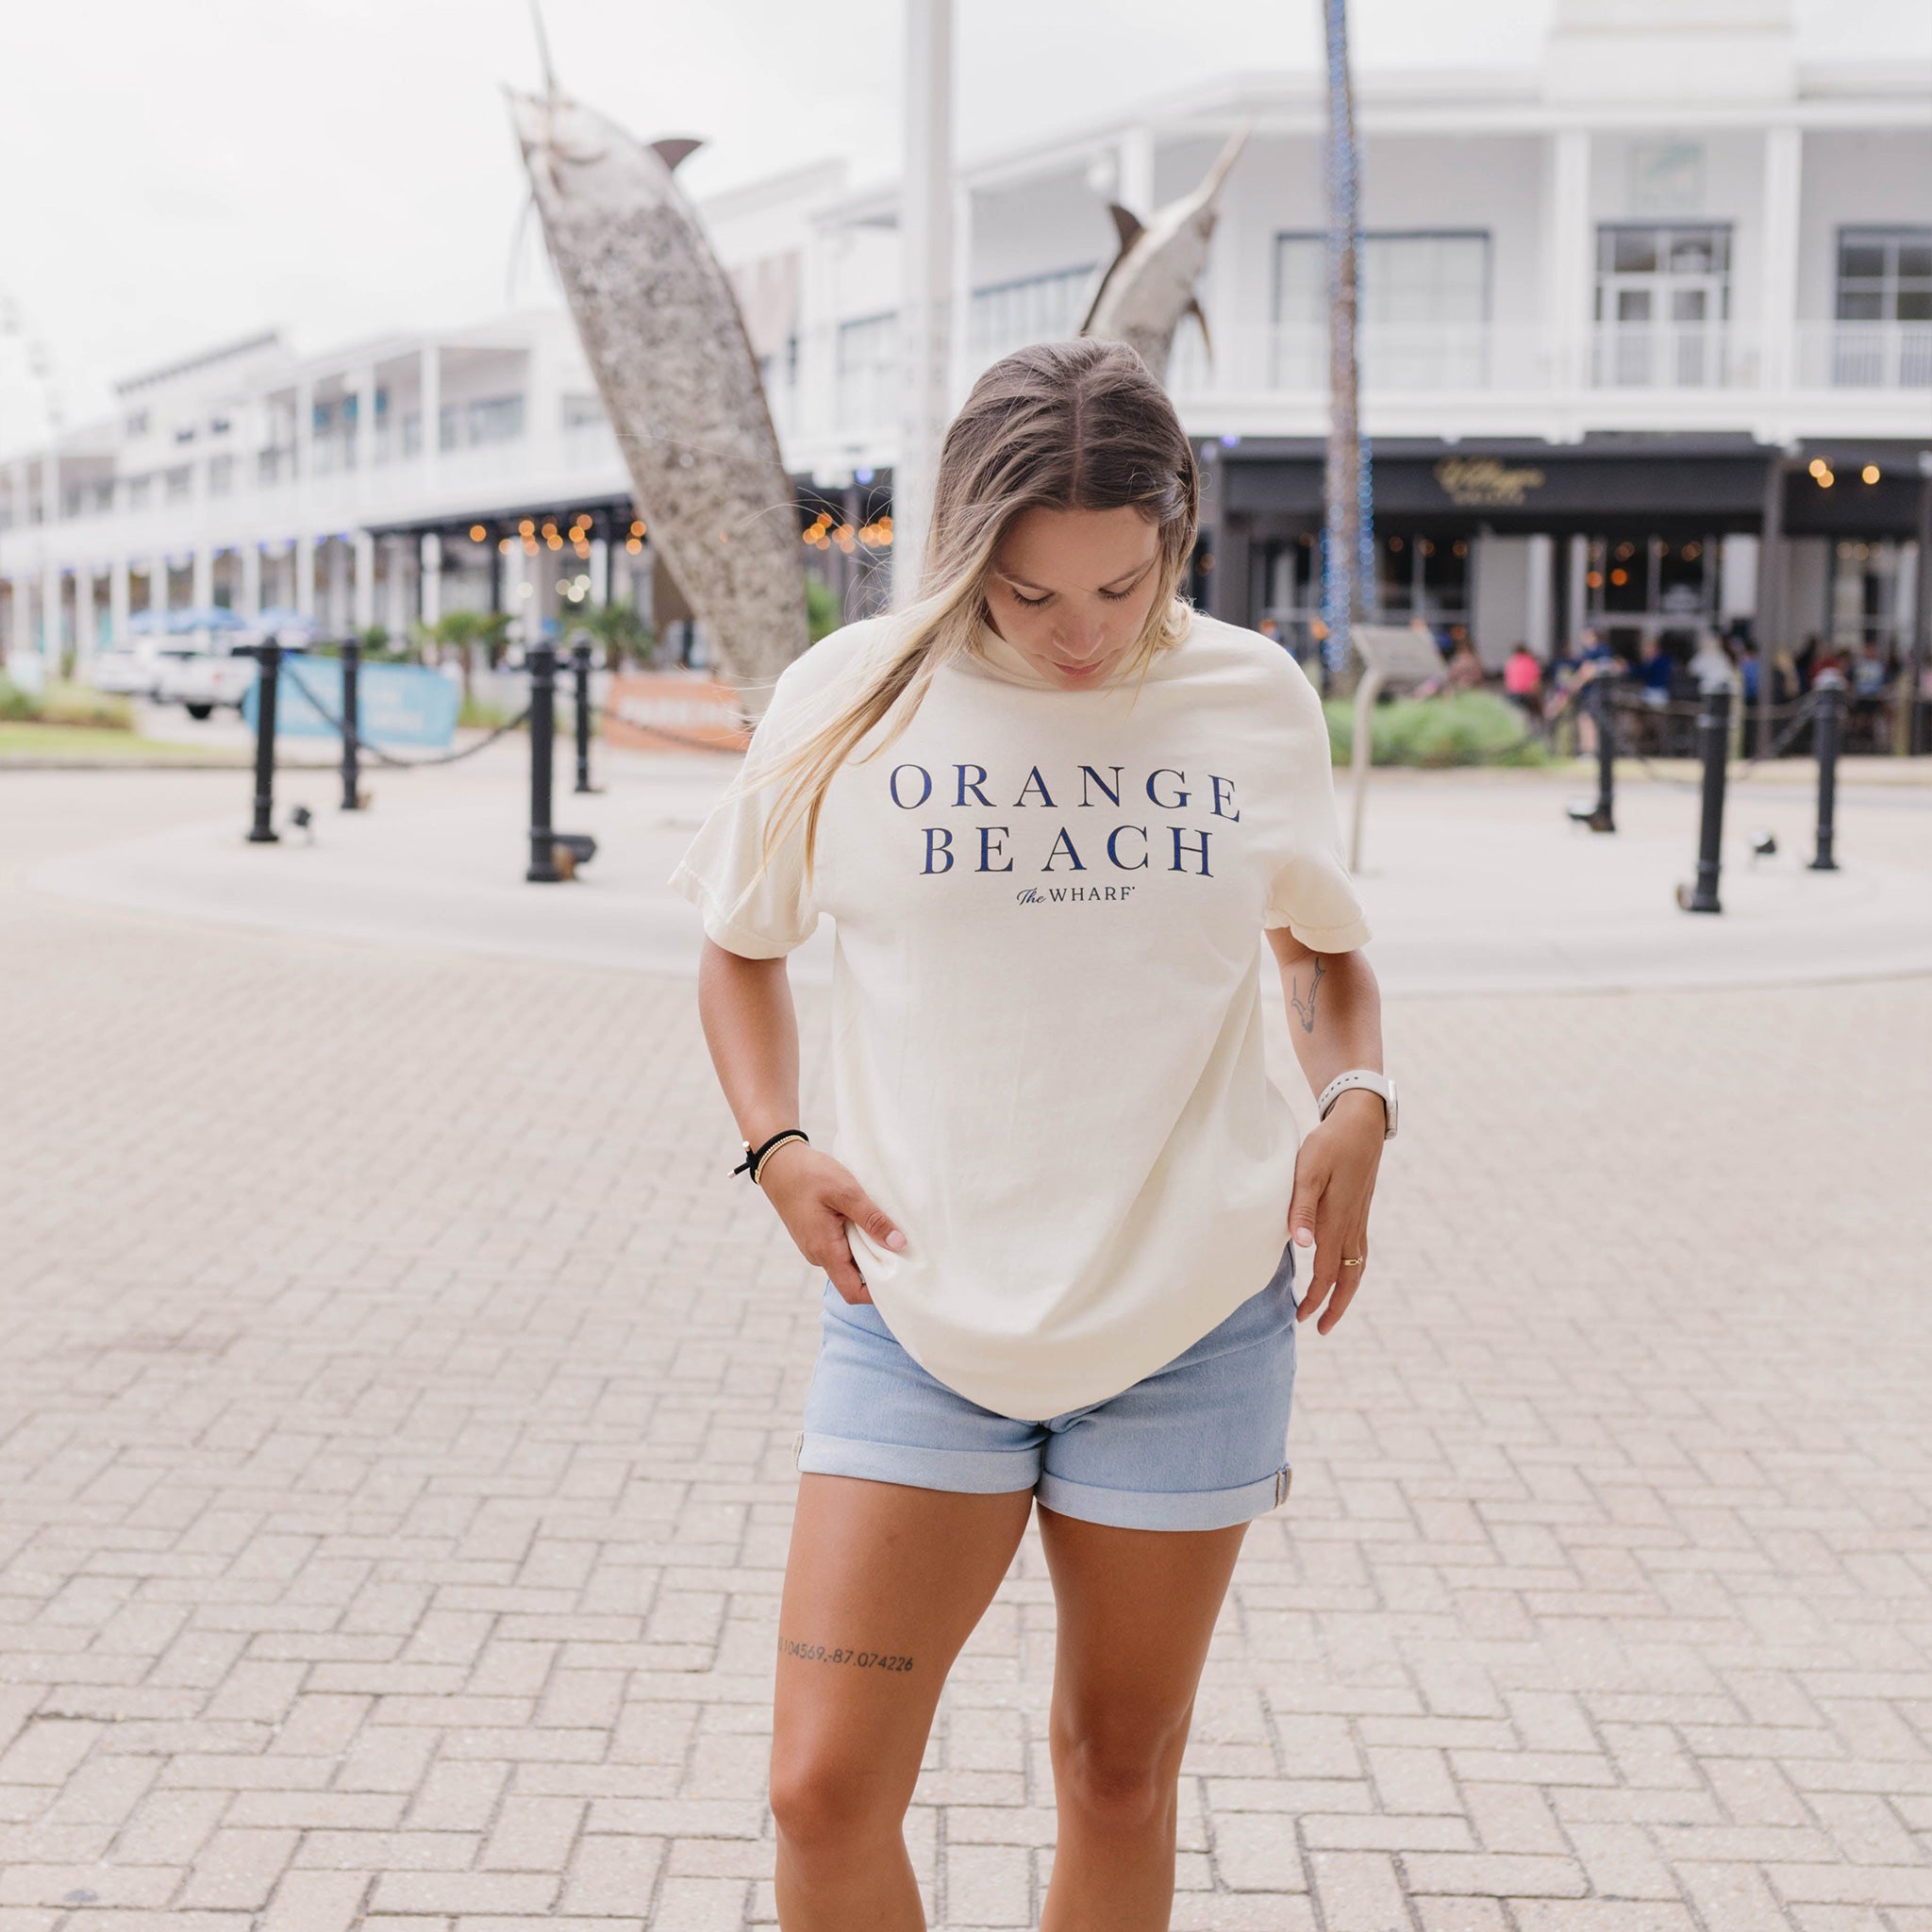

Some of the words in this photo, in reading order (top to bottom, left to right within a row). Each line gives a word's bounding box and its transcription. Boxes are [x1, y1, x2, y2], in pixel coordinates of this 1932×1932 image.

[890, 764, 1241, 823] ORANGE
[919, 825, 1214, 878] BEACH
[1016, 887, 1046, 906] The
[1048, 886, 1133, 903] WHARF
